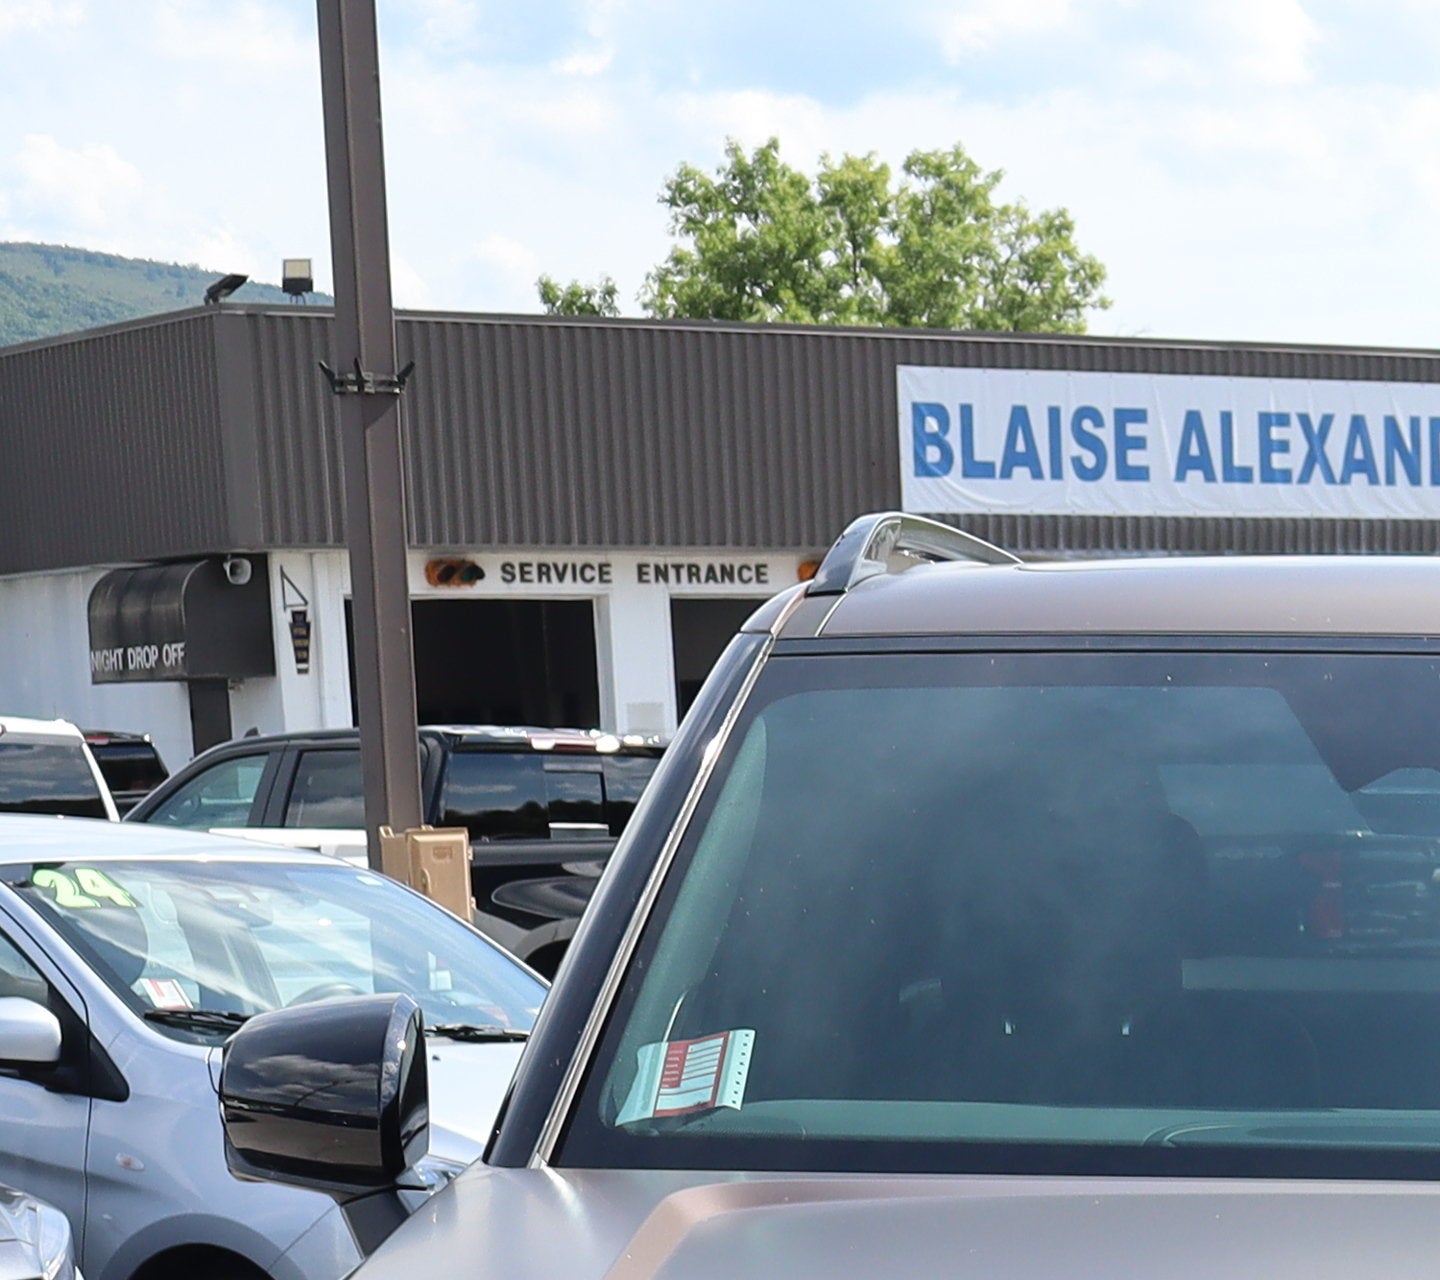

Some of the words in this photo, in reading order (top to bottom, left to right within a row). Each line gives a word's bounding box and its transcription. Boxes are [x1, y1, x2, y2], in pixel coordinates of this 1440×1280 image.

[911, 401, 1150, 483] BLAISE
[500, 561, 612, 584] SERVICE
[636, 562, 770, 584] ENTRANCE
[91, 647, 123, 672] NIGHT
[127, 644, 158, 671] DROP
[163, 641, 186, 667] OFF
[32, 868, 137, 909] 24
